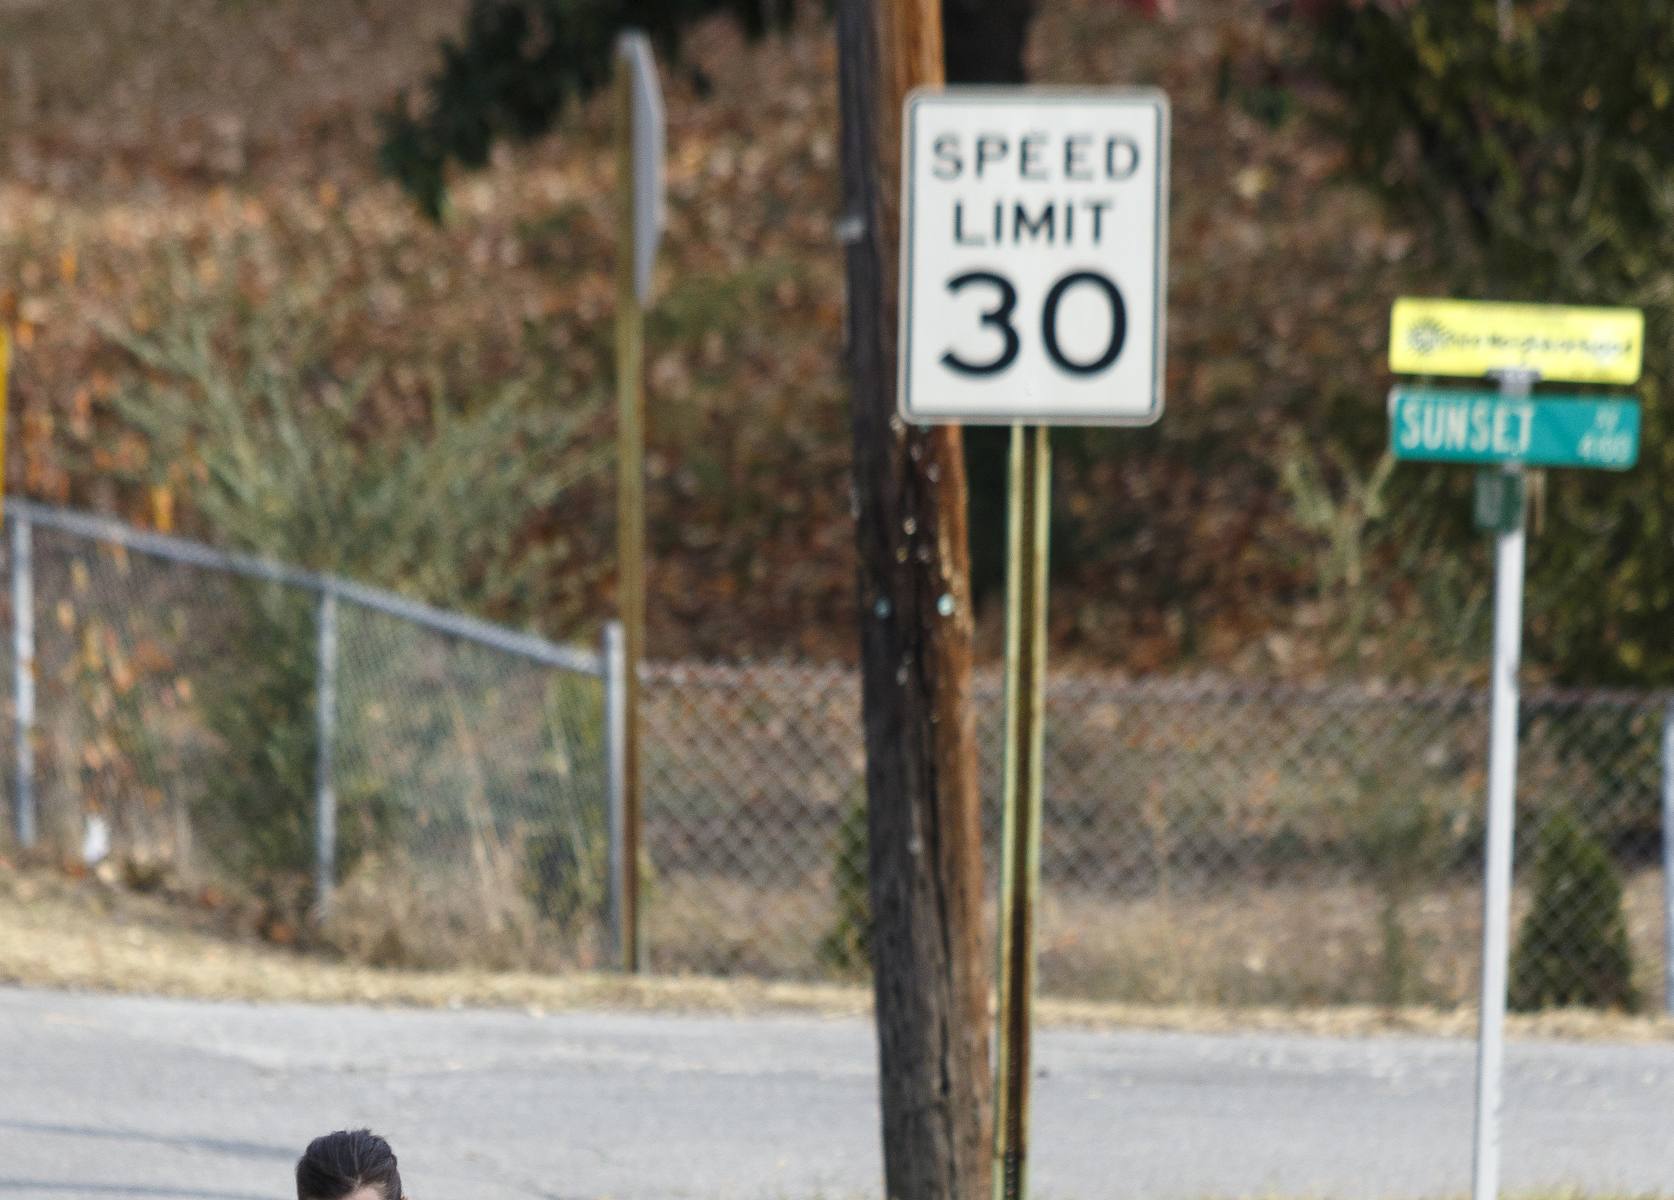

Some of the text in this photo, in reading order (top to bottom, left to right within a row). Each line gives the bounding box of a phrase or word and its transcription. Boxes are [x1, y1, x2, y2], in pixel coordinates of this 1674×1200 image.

[932, 132, 1140, 181] SPEED
[952, 201, 1115, 247] LIMIT
[938, 269, 1127, 380] 30
[1399, 399, 1534, 454] SUNSET
